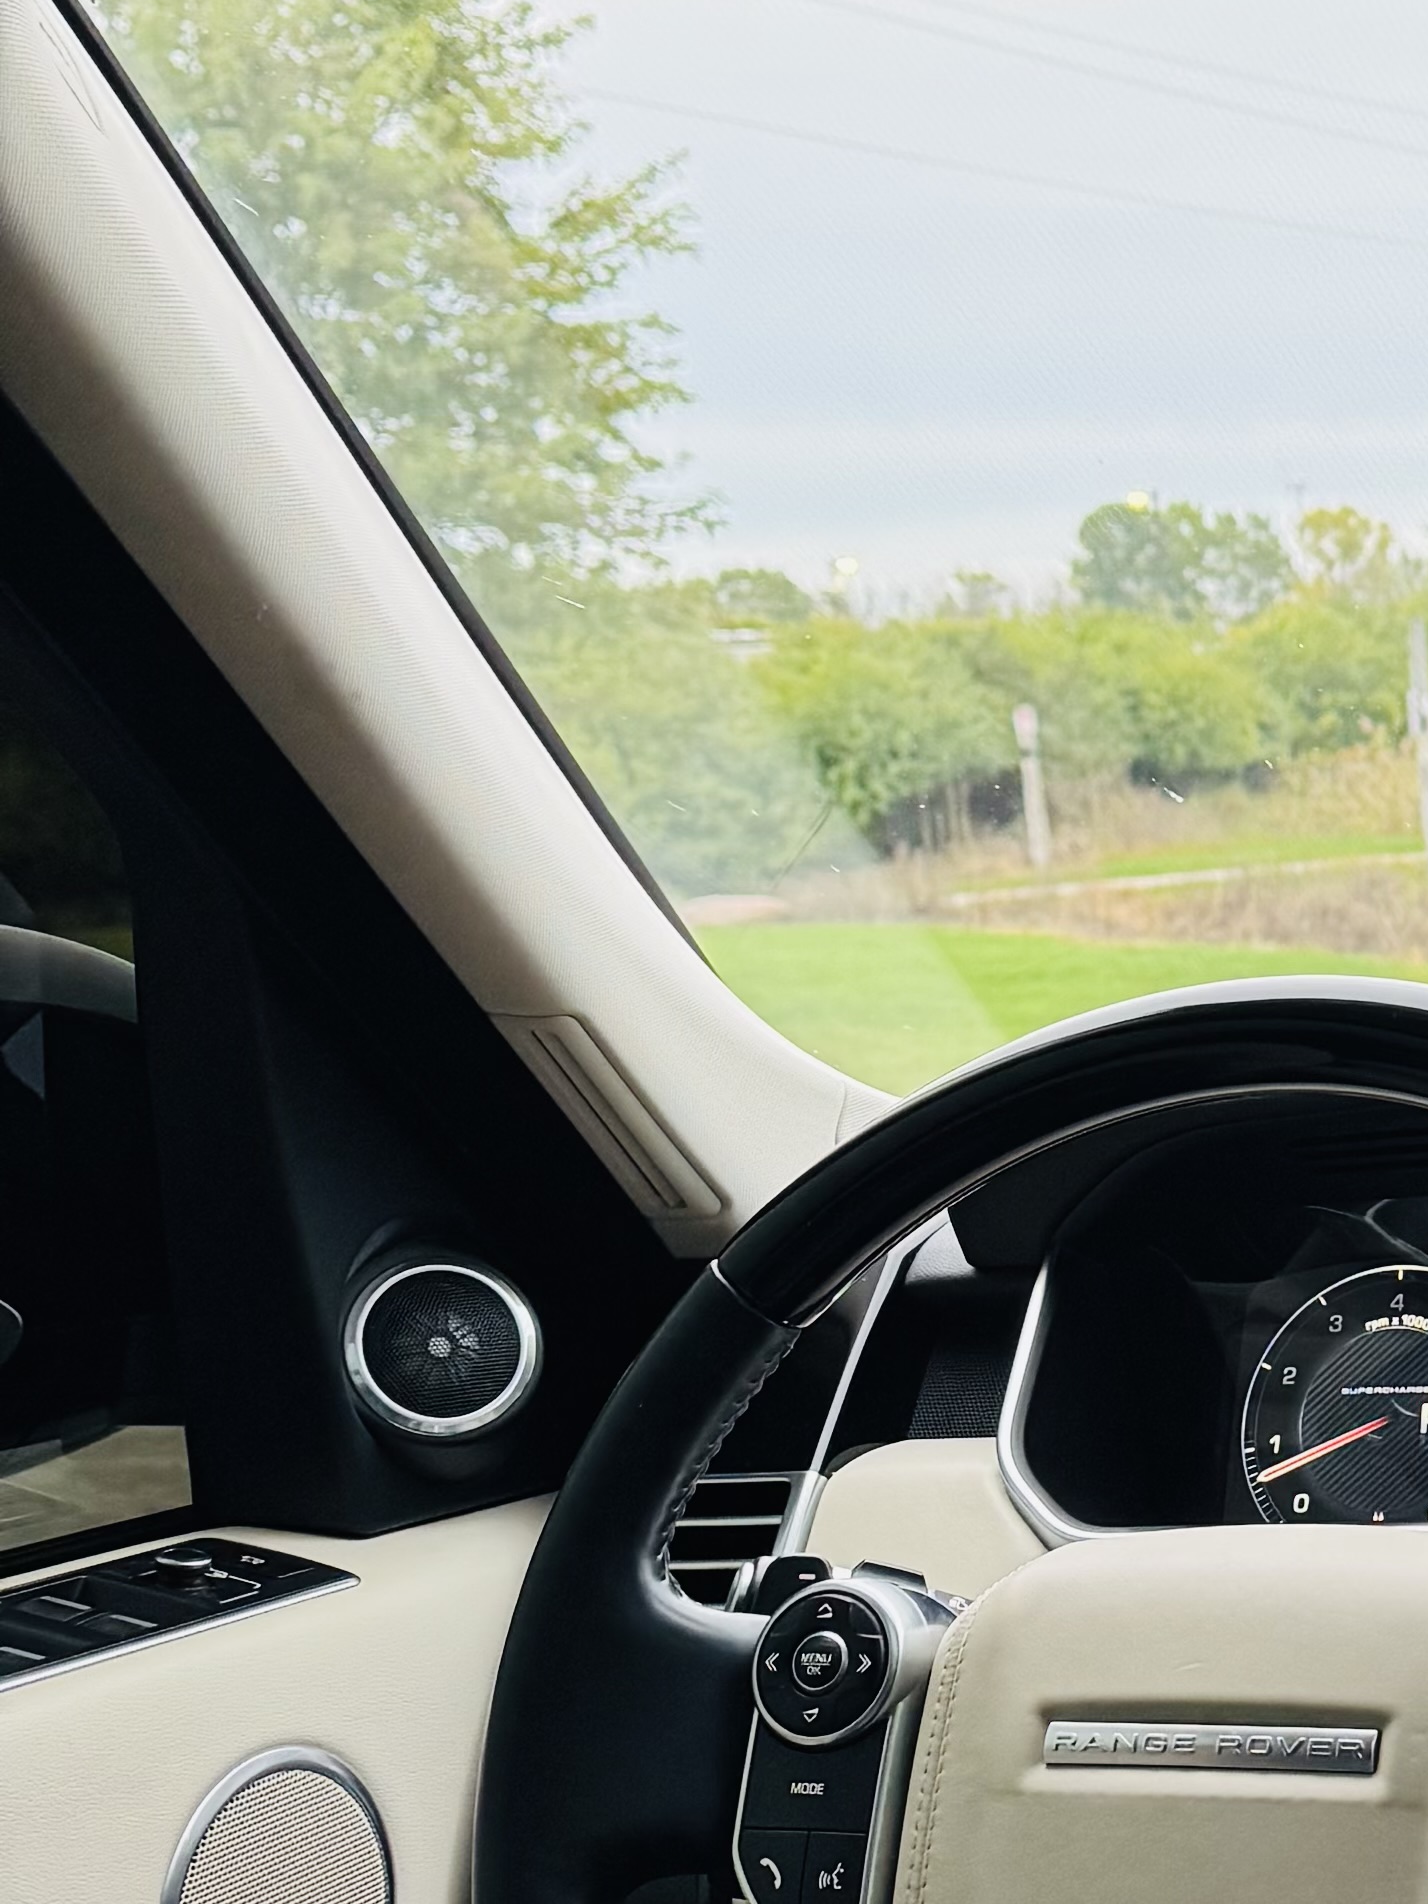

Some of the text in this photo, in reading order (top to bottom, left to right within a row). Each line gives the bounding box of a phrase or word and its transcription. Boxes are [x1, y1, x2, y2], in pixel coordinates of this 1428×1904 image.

[1390, 1294, 1404, 1311] 4
[1329, 1314, 1343, 1333] 3
[1364, 1316, 1390, 1332] rpm
[1282, 1366, 1297, 1384] 2
[1269, 1434, 1282, 1454] 1
[1293, 1492, 1310, 1514] 0
[801, 1653, 832, 1663] MENU
[806, 1665, 822, 1676] OK
[1051, 1731, 1366, 1760] RANGE ROVER
[790, 1782, 825, 1796] MODE
